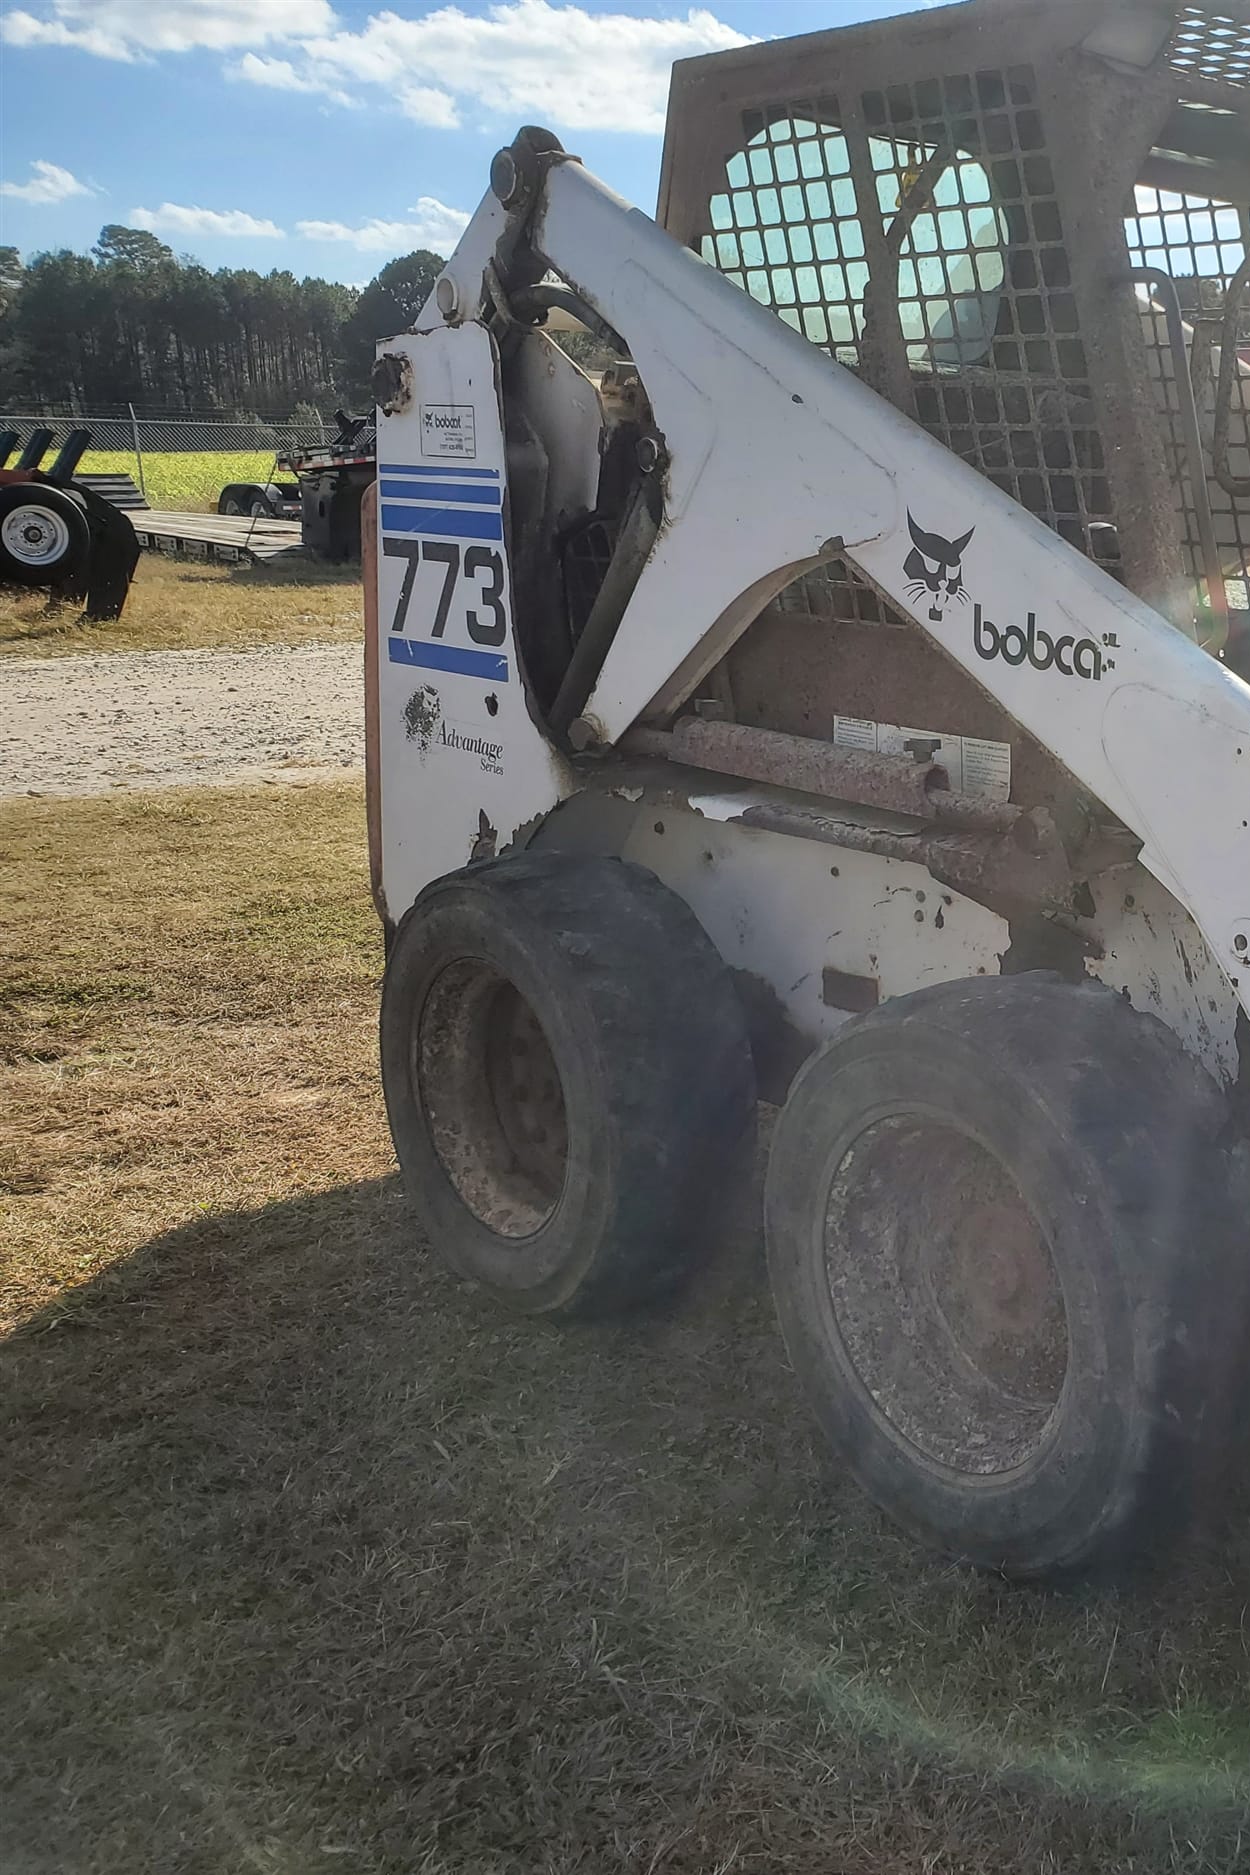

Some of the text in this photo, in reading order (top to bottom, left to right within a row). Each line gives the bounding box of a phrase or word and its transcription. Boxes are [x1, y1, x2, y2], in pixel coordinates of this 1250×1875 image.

[382, 537, 507, 647] 773
[435, 720, 503, 763] Advantage
[480, 758, 503, 776] Series
